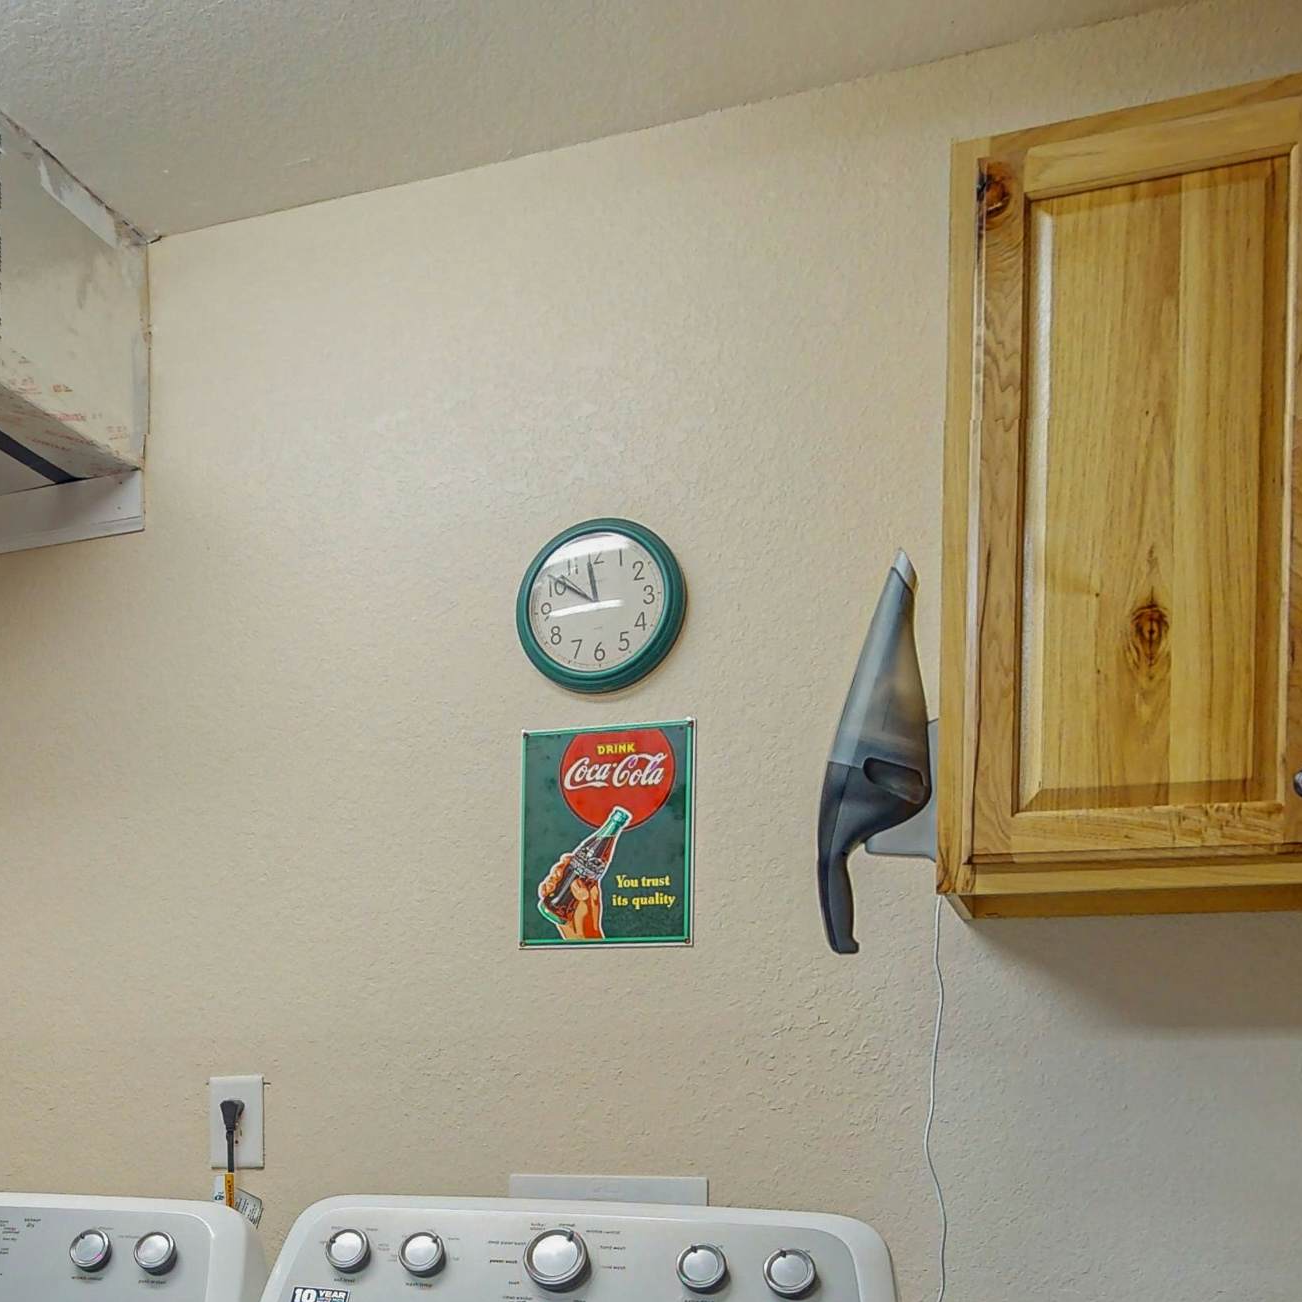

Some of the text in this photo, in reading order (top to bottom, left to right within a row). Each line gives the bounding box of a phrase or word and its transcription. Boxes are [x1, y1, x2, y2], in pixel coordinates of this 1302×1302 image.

[632, 561, 644, 580] 2
[643, 585, 655, 605] 3
[634, 612, 647, 631] 4
[550, 626, 562, 645] 8
[618, 632, 630, 651] 5
[571, 639, 583, 659] 7
[594, 642, 605, 661] 6
[597, 743, 636, 756] DRINK
[563, 752, 668, 791] Coca-Cola
[616, 875, 671, 888] You trust
[612, 891, 676, 910] its quality
[317, 1290, 348, 1299] YEAR
